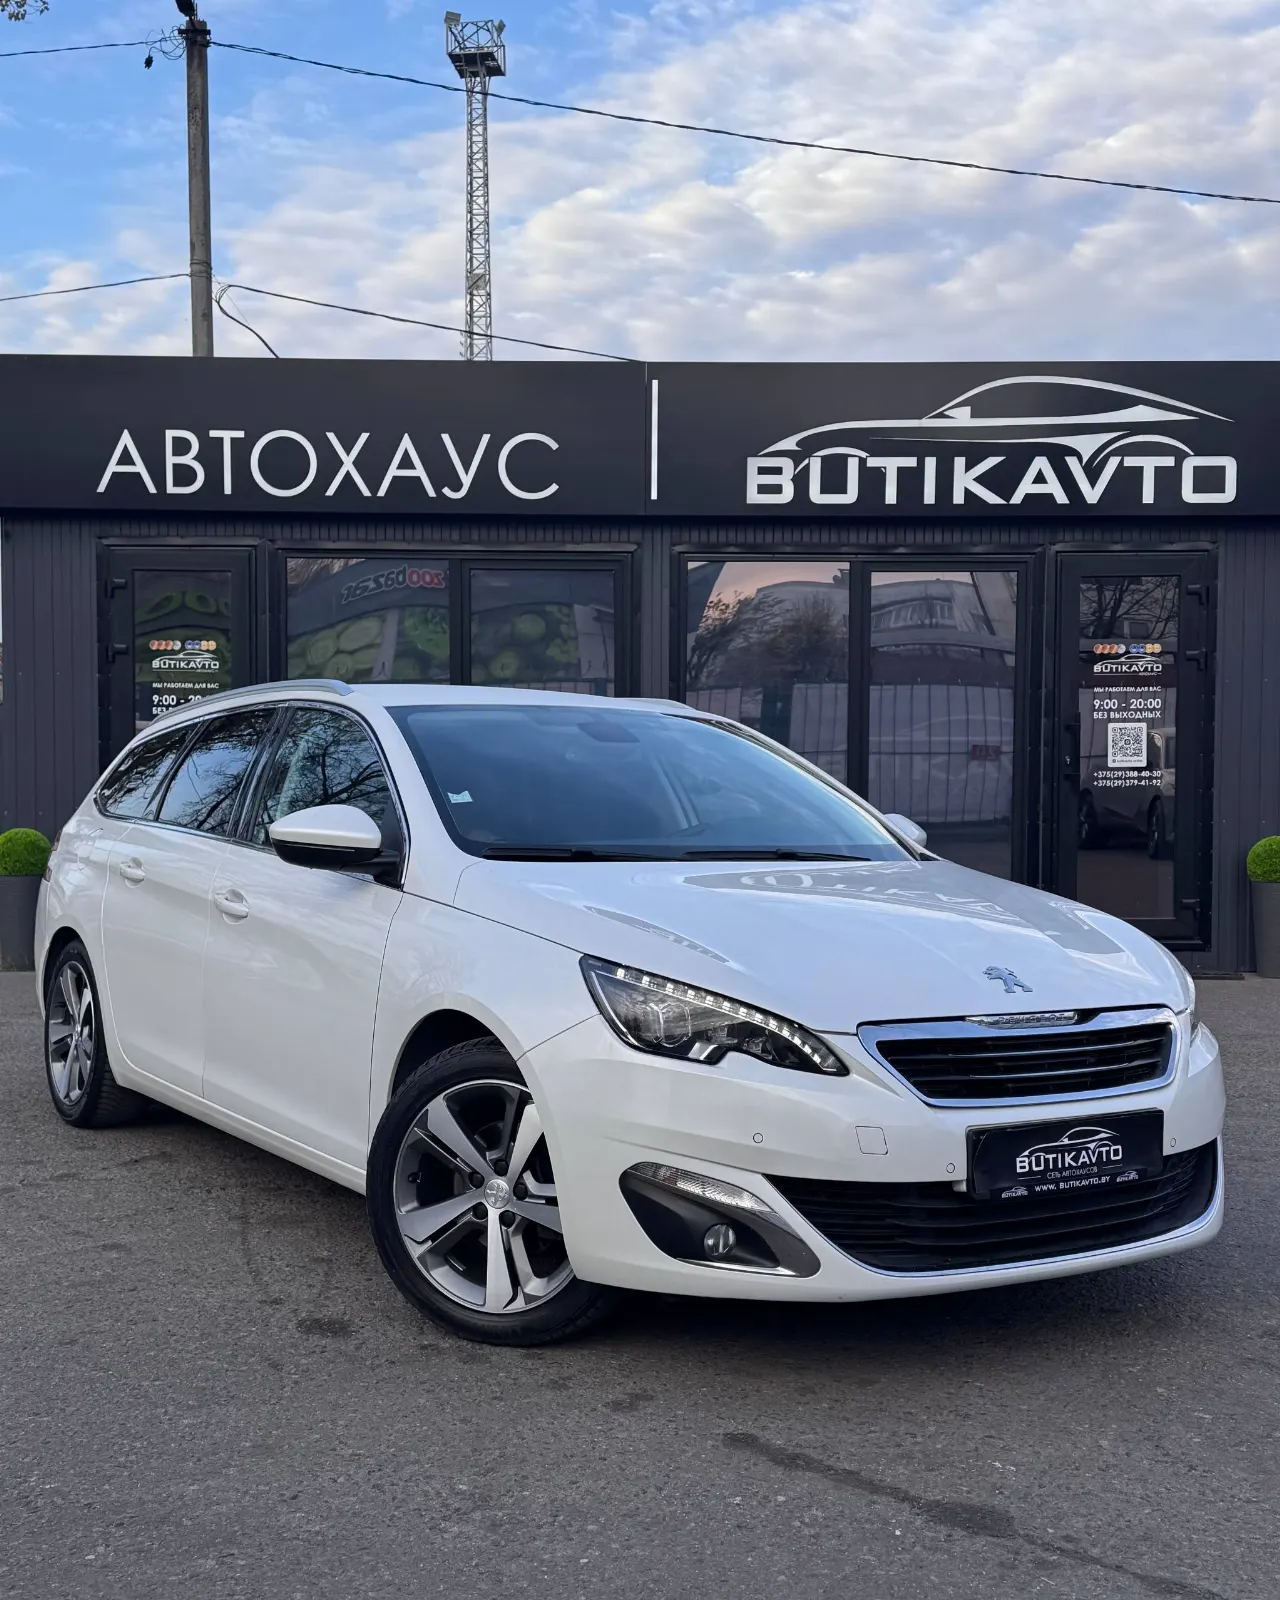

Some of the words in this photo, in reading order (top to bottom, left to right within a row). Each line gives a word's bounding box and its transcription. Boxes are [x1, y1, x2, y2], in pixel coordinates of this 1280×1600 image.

[96, 428, 560, 501] АВТОХАУС
[746, 455, 1238, 505] BUTIKAVTO
[152, 660, 219, 669] BUTIKAVTO
[1093, 664, 1162, 673] BUTIKAVTO
[152, 694, 177, 706] 9:00
[1093, 699, 1118, 710] 9:00
[1129, 698, 1162, 709] 20:00
[1093, 711, 1107, 719] БЕЗ
[1110, 710, 1161, 719] ВЫХОДНЫХ
[1093, 770, 1162, 778] +375(29)388-40-30
[1093, 779, 1162, 788] +375(29)379-41-92
[1017, 1145, 1123, 1173] BUTIKAVTO
[1059, 1175, 1111, 1189] BUTIKAVTO.BY
